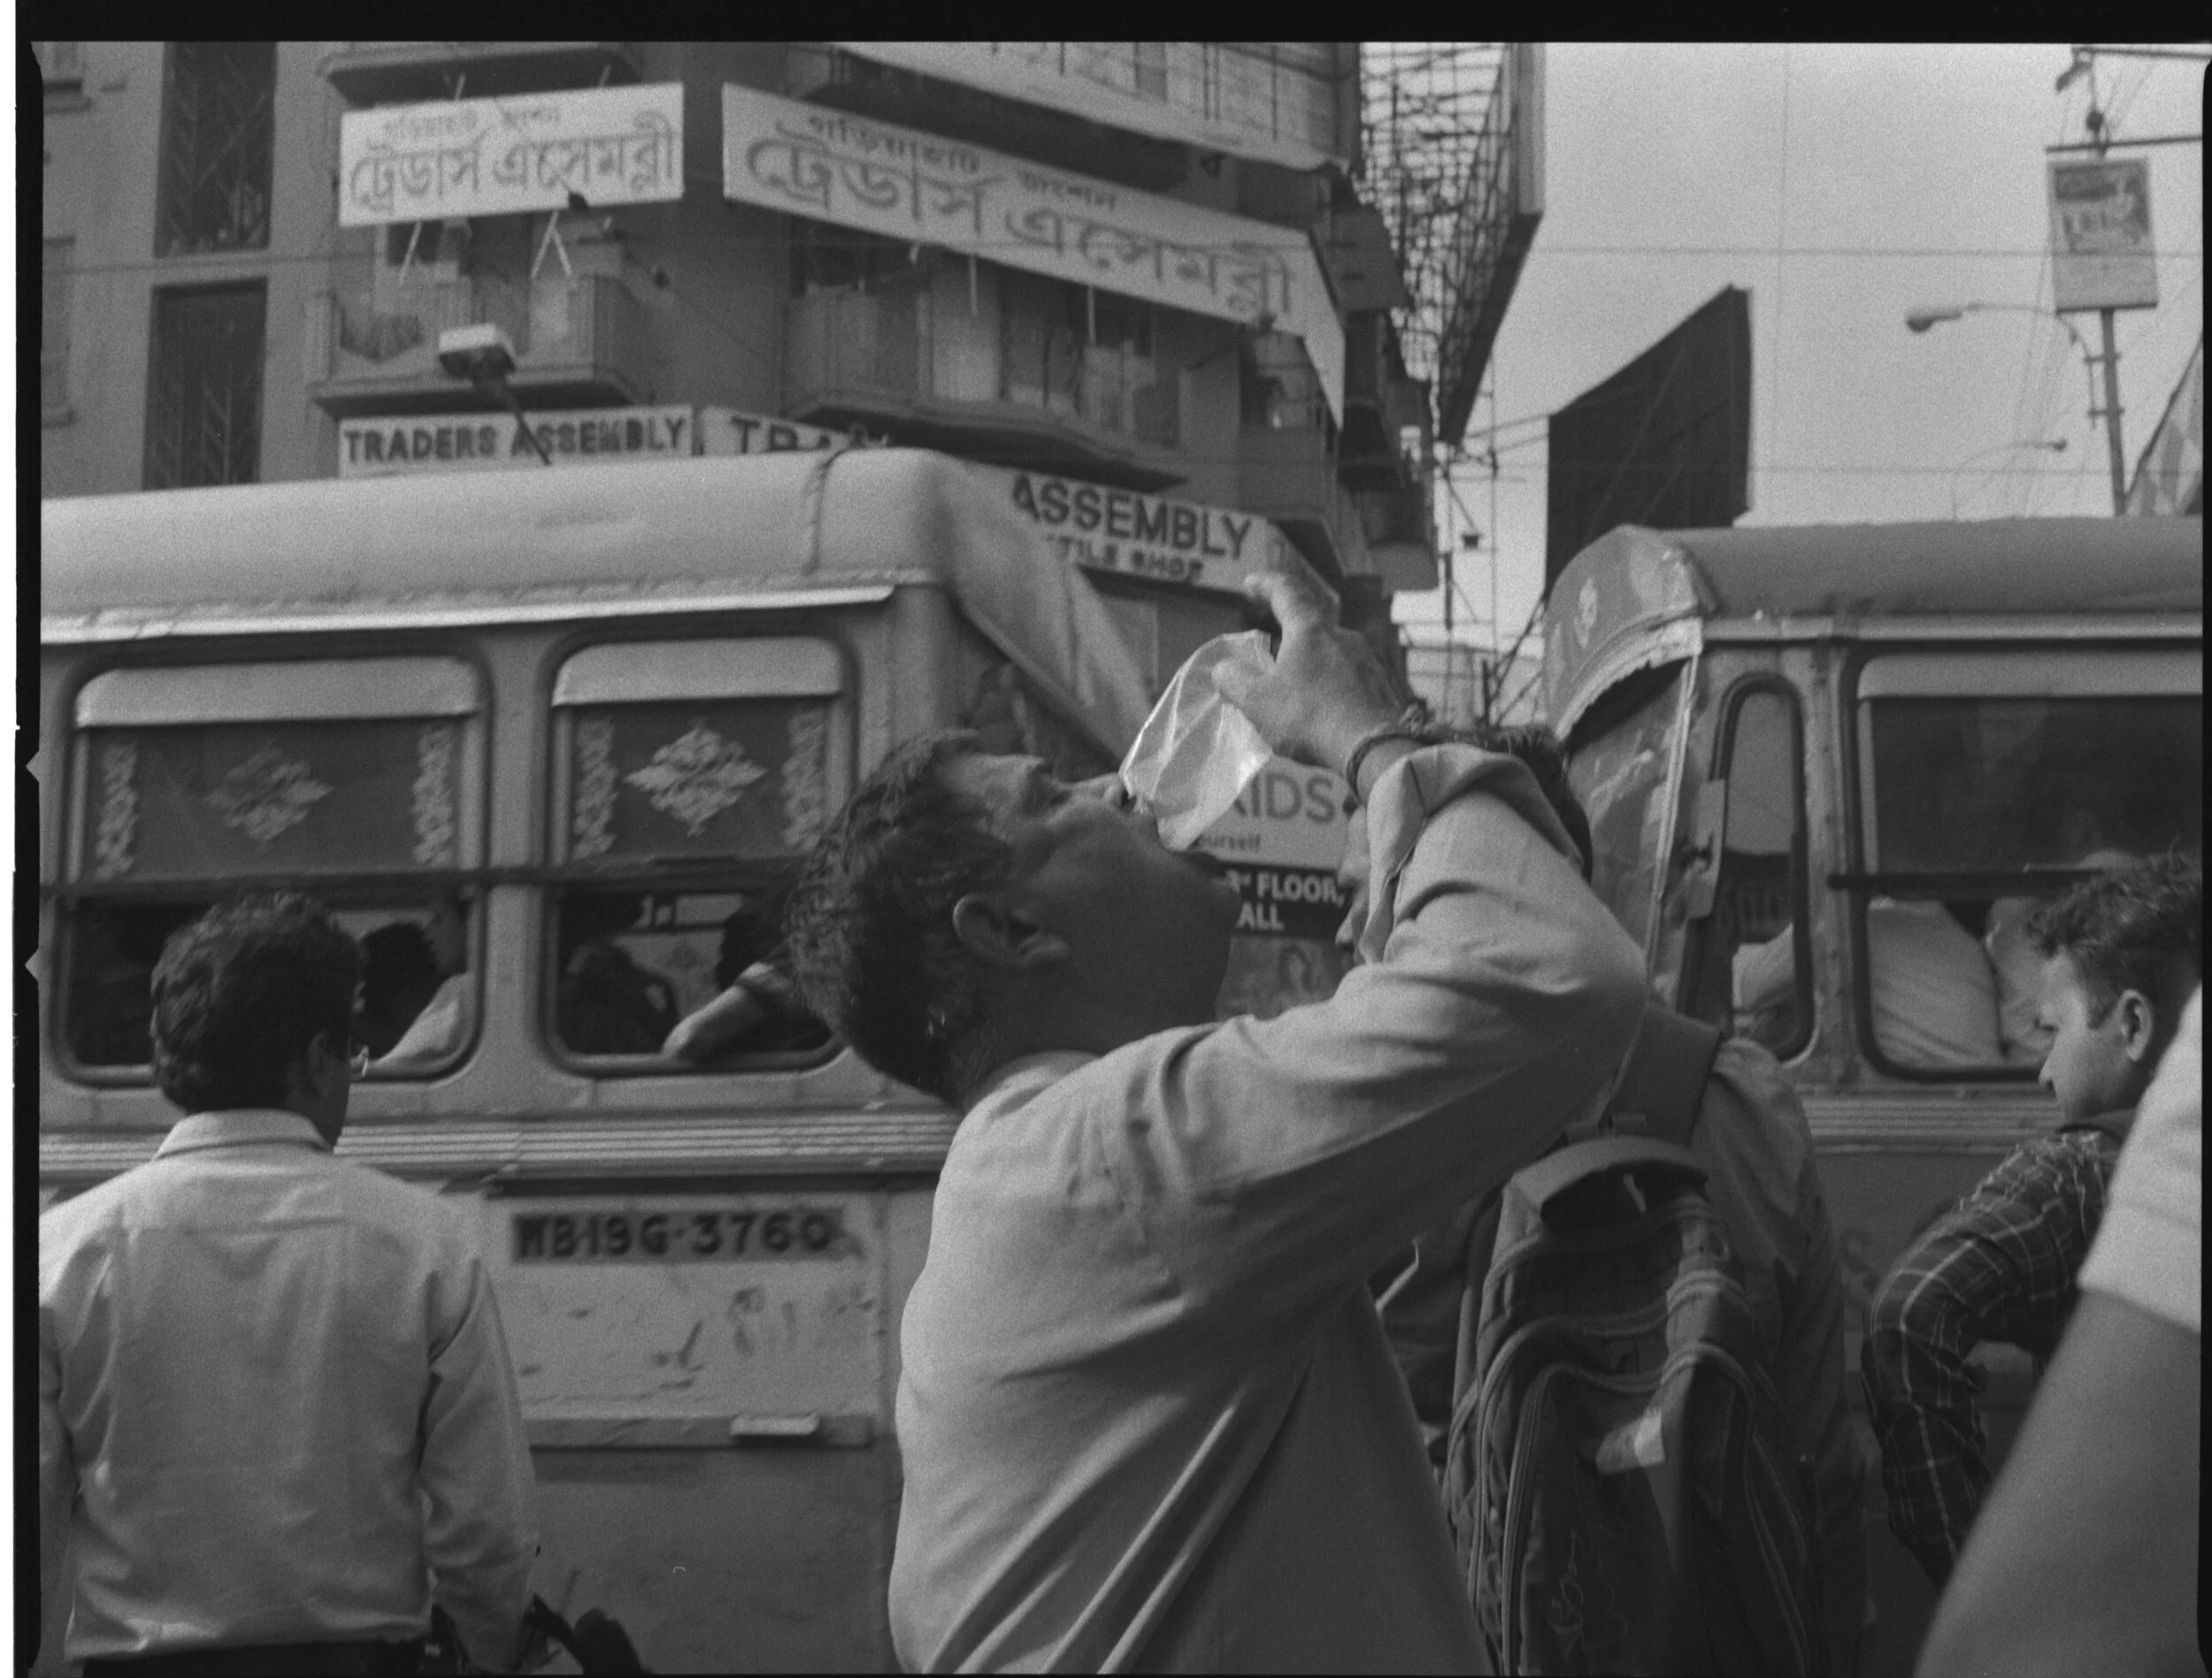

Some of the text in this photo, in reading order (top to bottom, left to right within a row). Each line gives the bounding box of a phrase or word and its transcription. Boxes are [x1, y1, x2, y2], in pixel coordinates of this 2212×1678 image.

[344, 416, 686, 464] TRADERS ASSEMBLY
[1013, 474, 1252, 560] ASSEMBLY
